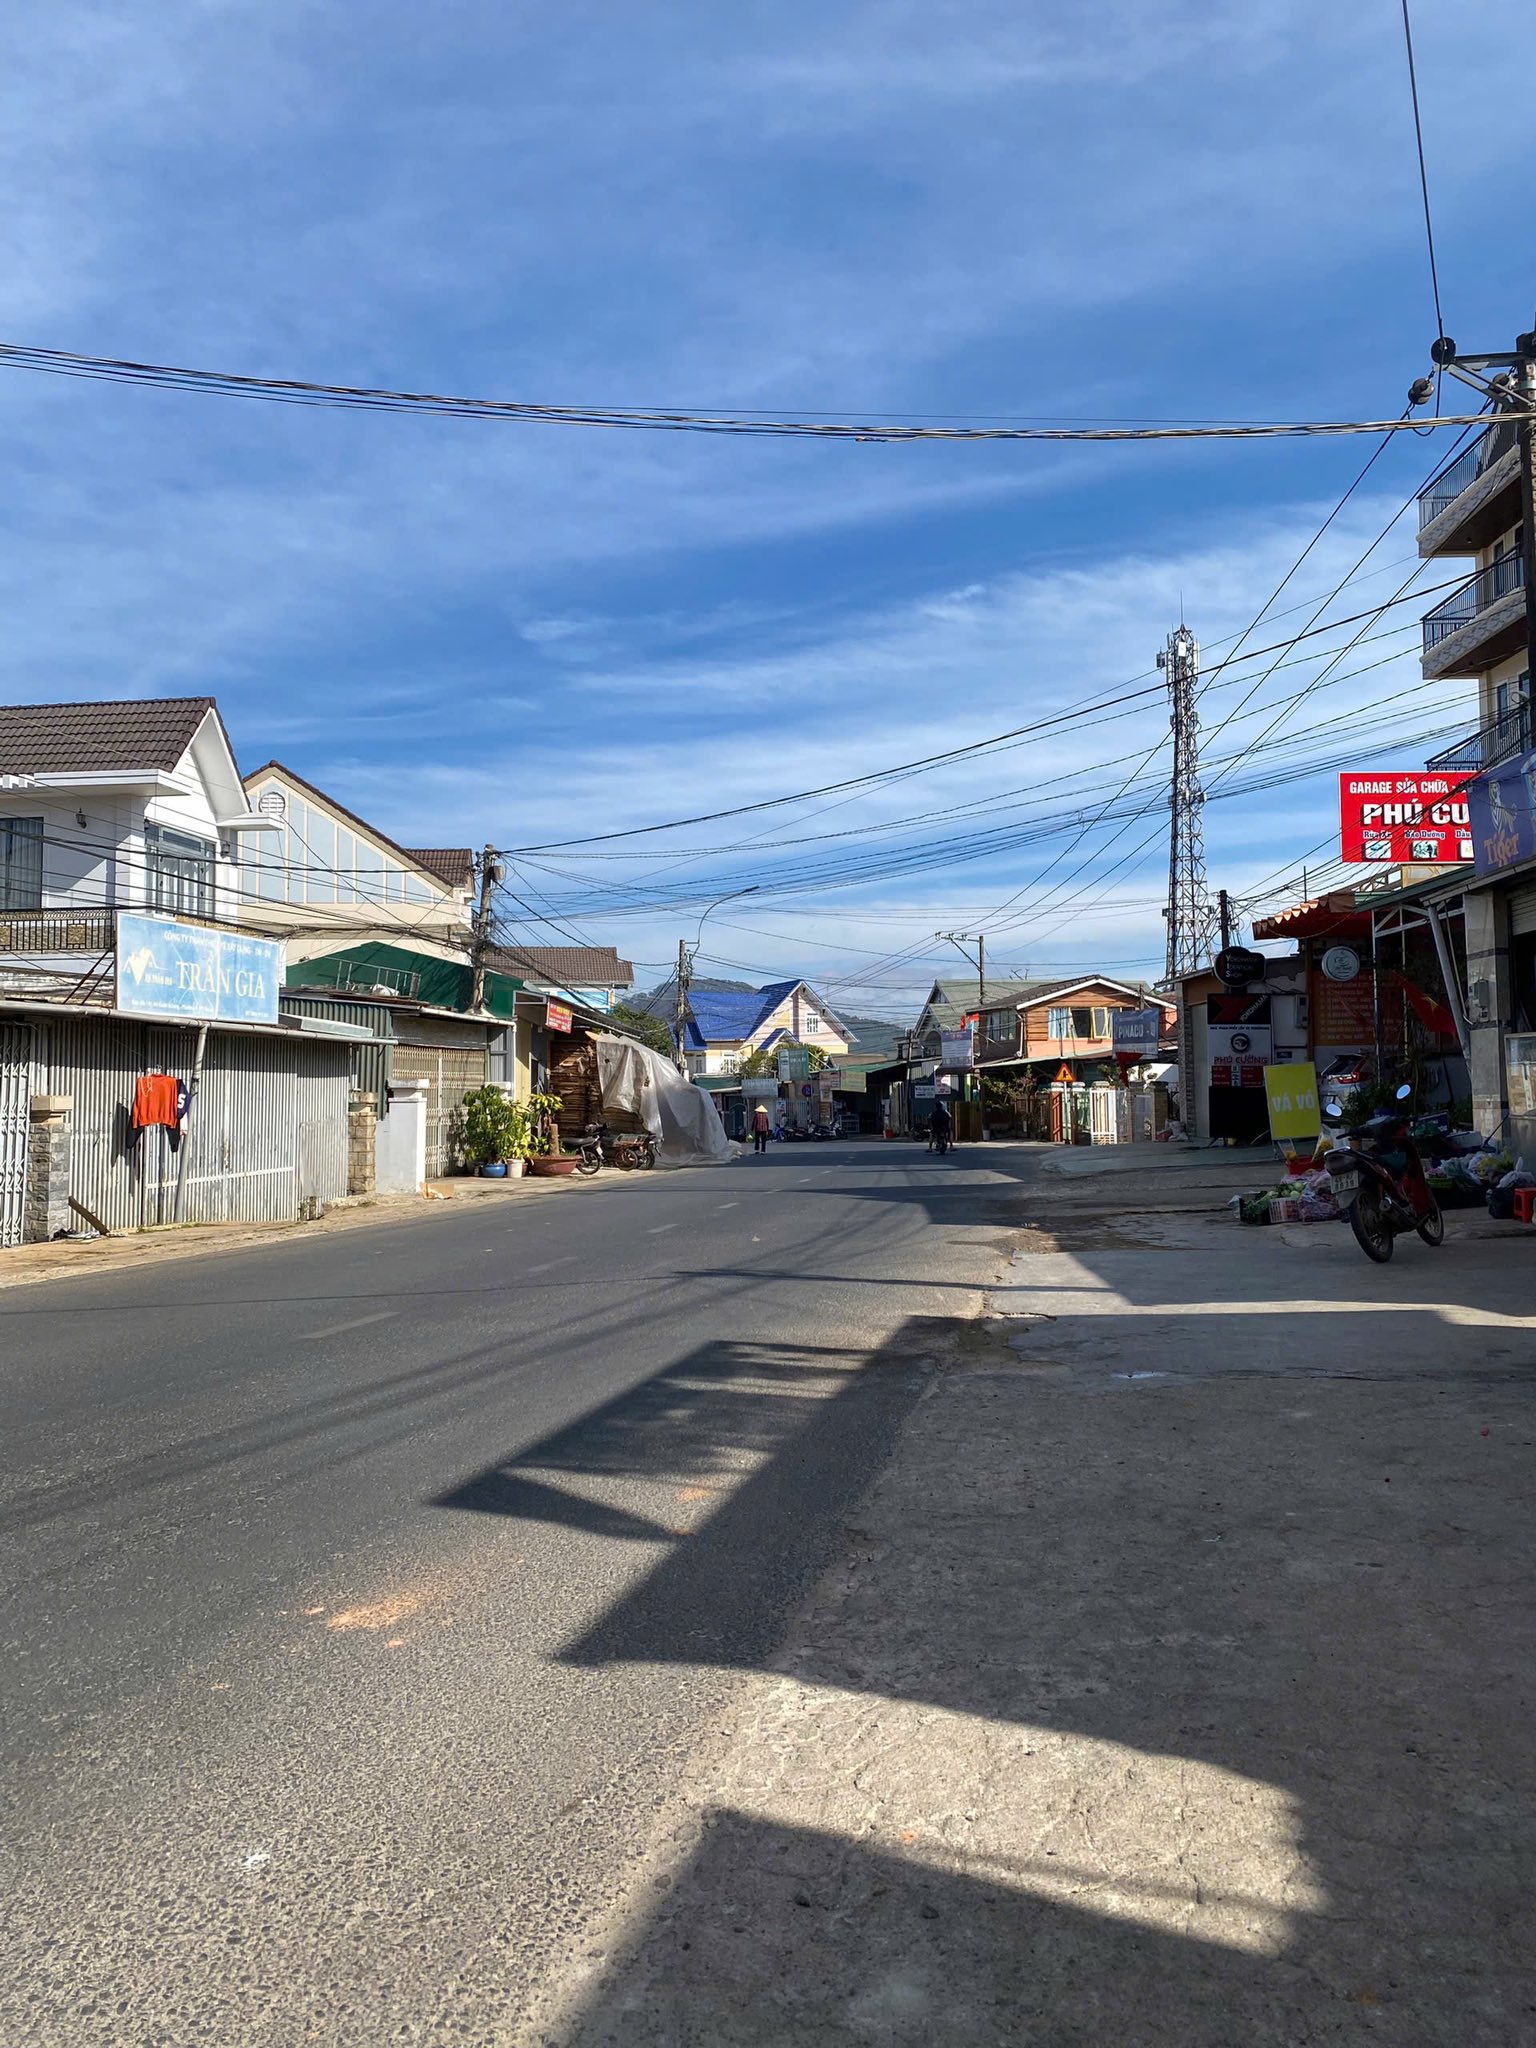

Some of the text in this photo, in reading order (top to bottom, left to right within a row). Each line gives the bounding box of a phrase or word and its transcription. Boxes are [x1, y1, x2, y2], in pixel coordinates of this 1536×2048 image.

[1350, 781, 1392, 794] GARAGE
[1396, 777, 1417, 794] SỬA
[1421, 778, 1448, 794] CHỮA
[1363, 798, 1424, 825] PHÚ
[1483, 832, 1519, 868] Tiger
[236, 970, 264, 998] GIA
[1239, 995, 1269, 1023] YOKOHAMA
[1214, 1055, 1232, 1064] PHÚ
